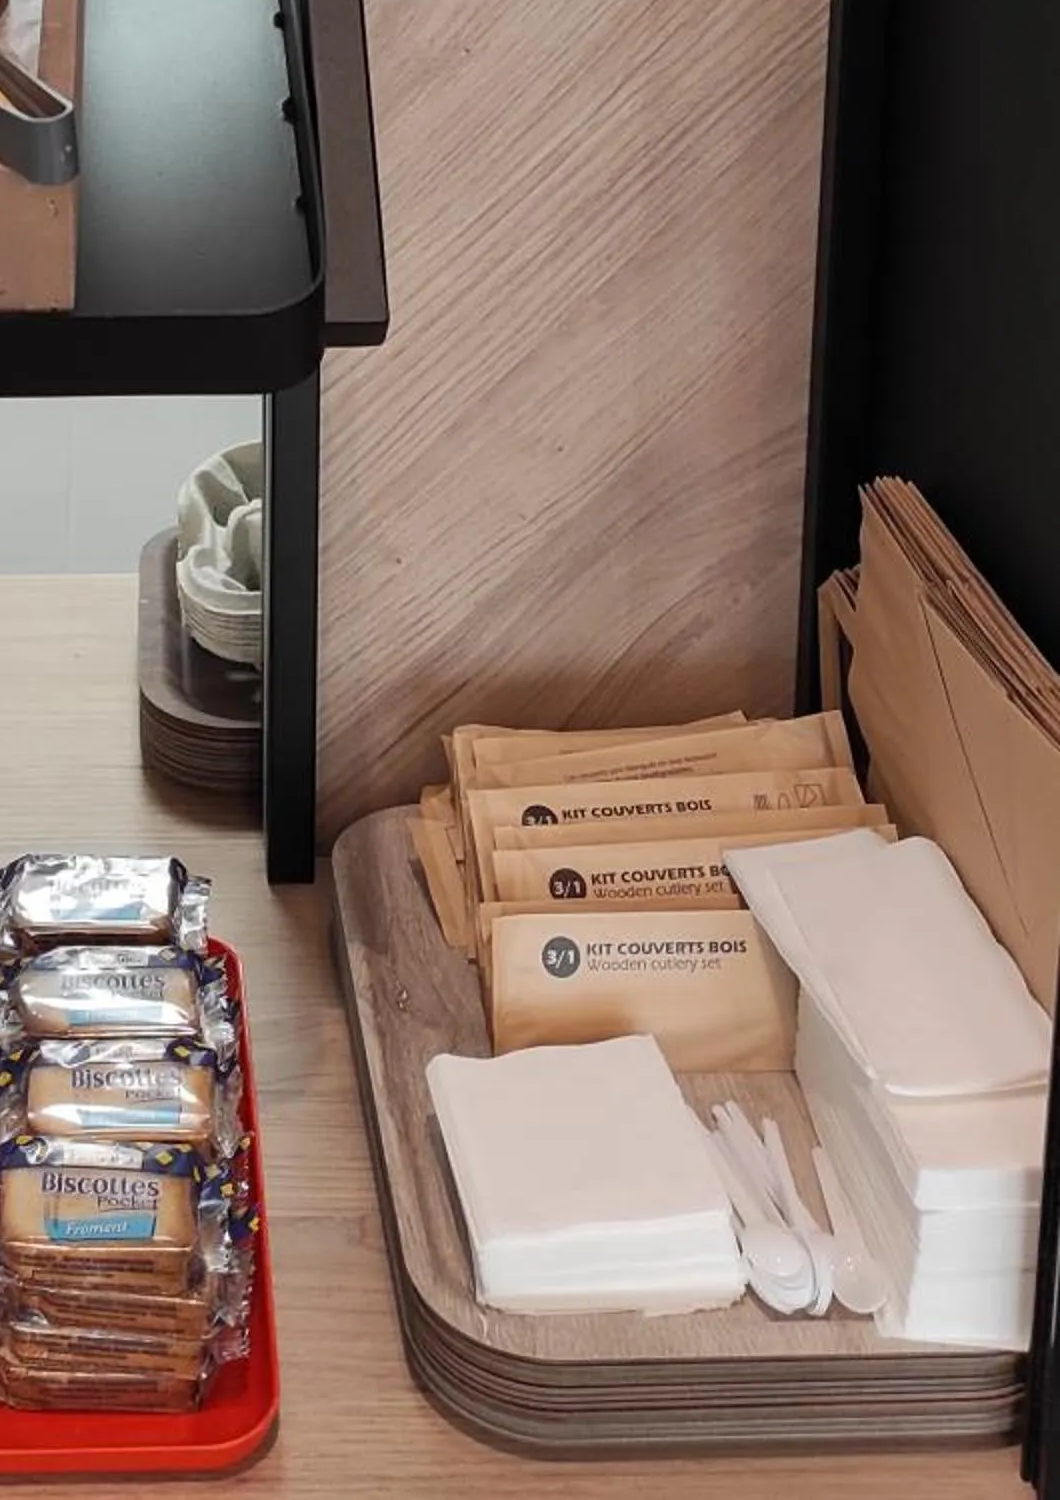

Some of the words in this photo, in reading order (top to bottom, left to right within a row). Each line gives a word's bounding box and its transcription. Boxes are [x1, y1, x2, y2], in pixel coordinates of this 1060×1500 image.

[561, 807, 587, 820] KIT
[591, 802, 672, 818] COUVERTS
[677, 799, 712, 813] BOIS
[591, 872, 616, 885] KIT
[621, 866, 706, 883] COUVERTS
[710, 864, 730, 877] BO
[552, 880, 581, 897] 3/1
[593, 884, 652, 899] Wooden
[655, 881, 701, 897] cutlery
[705, 881, 725, 893] set
[586, 943, 611, 956] KIT
[617, 941, 704, 955] COUVERTS
[709, 940, 747, 954] BOIS
[546, 949, 575, 967] 3/1
[587, 958, 647, 972] Wooden
[651, 957, 697, 973] cutlery
[701, 958, 722, 970] set
[71, 1067, 182, 1089] Biscottes
[41, 1171, 160, 1198] Biscottes
